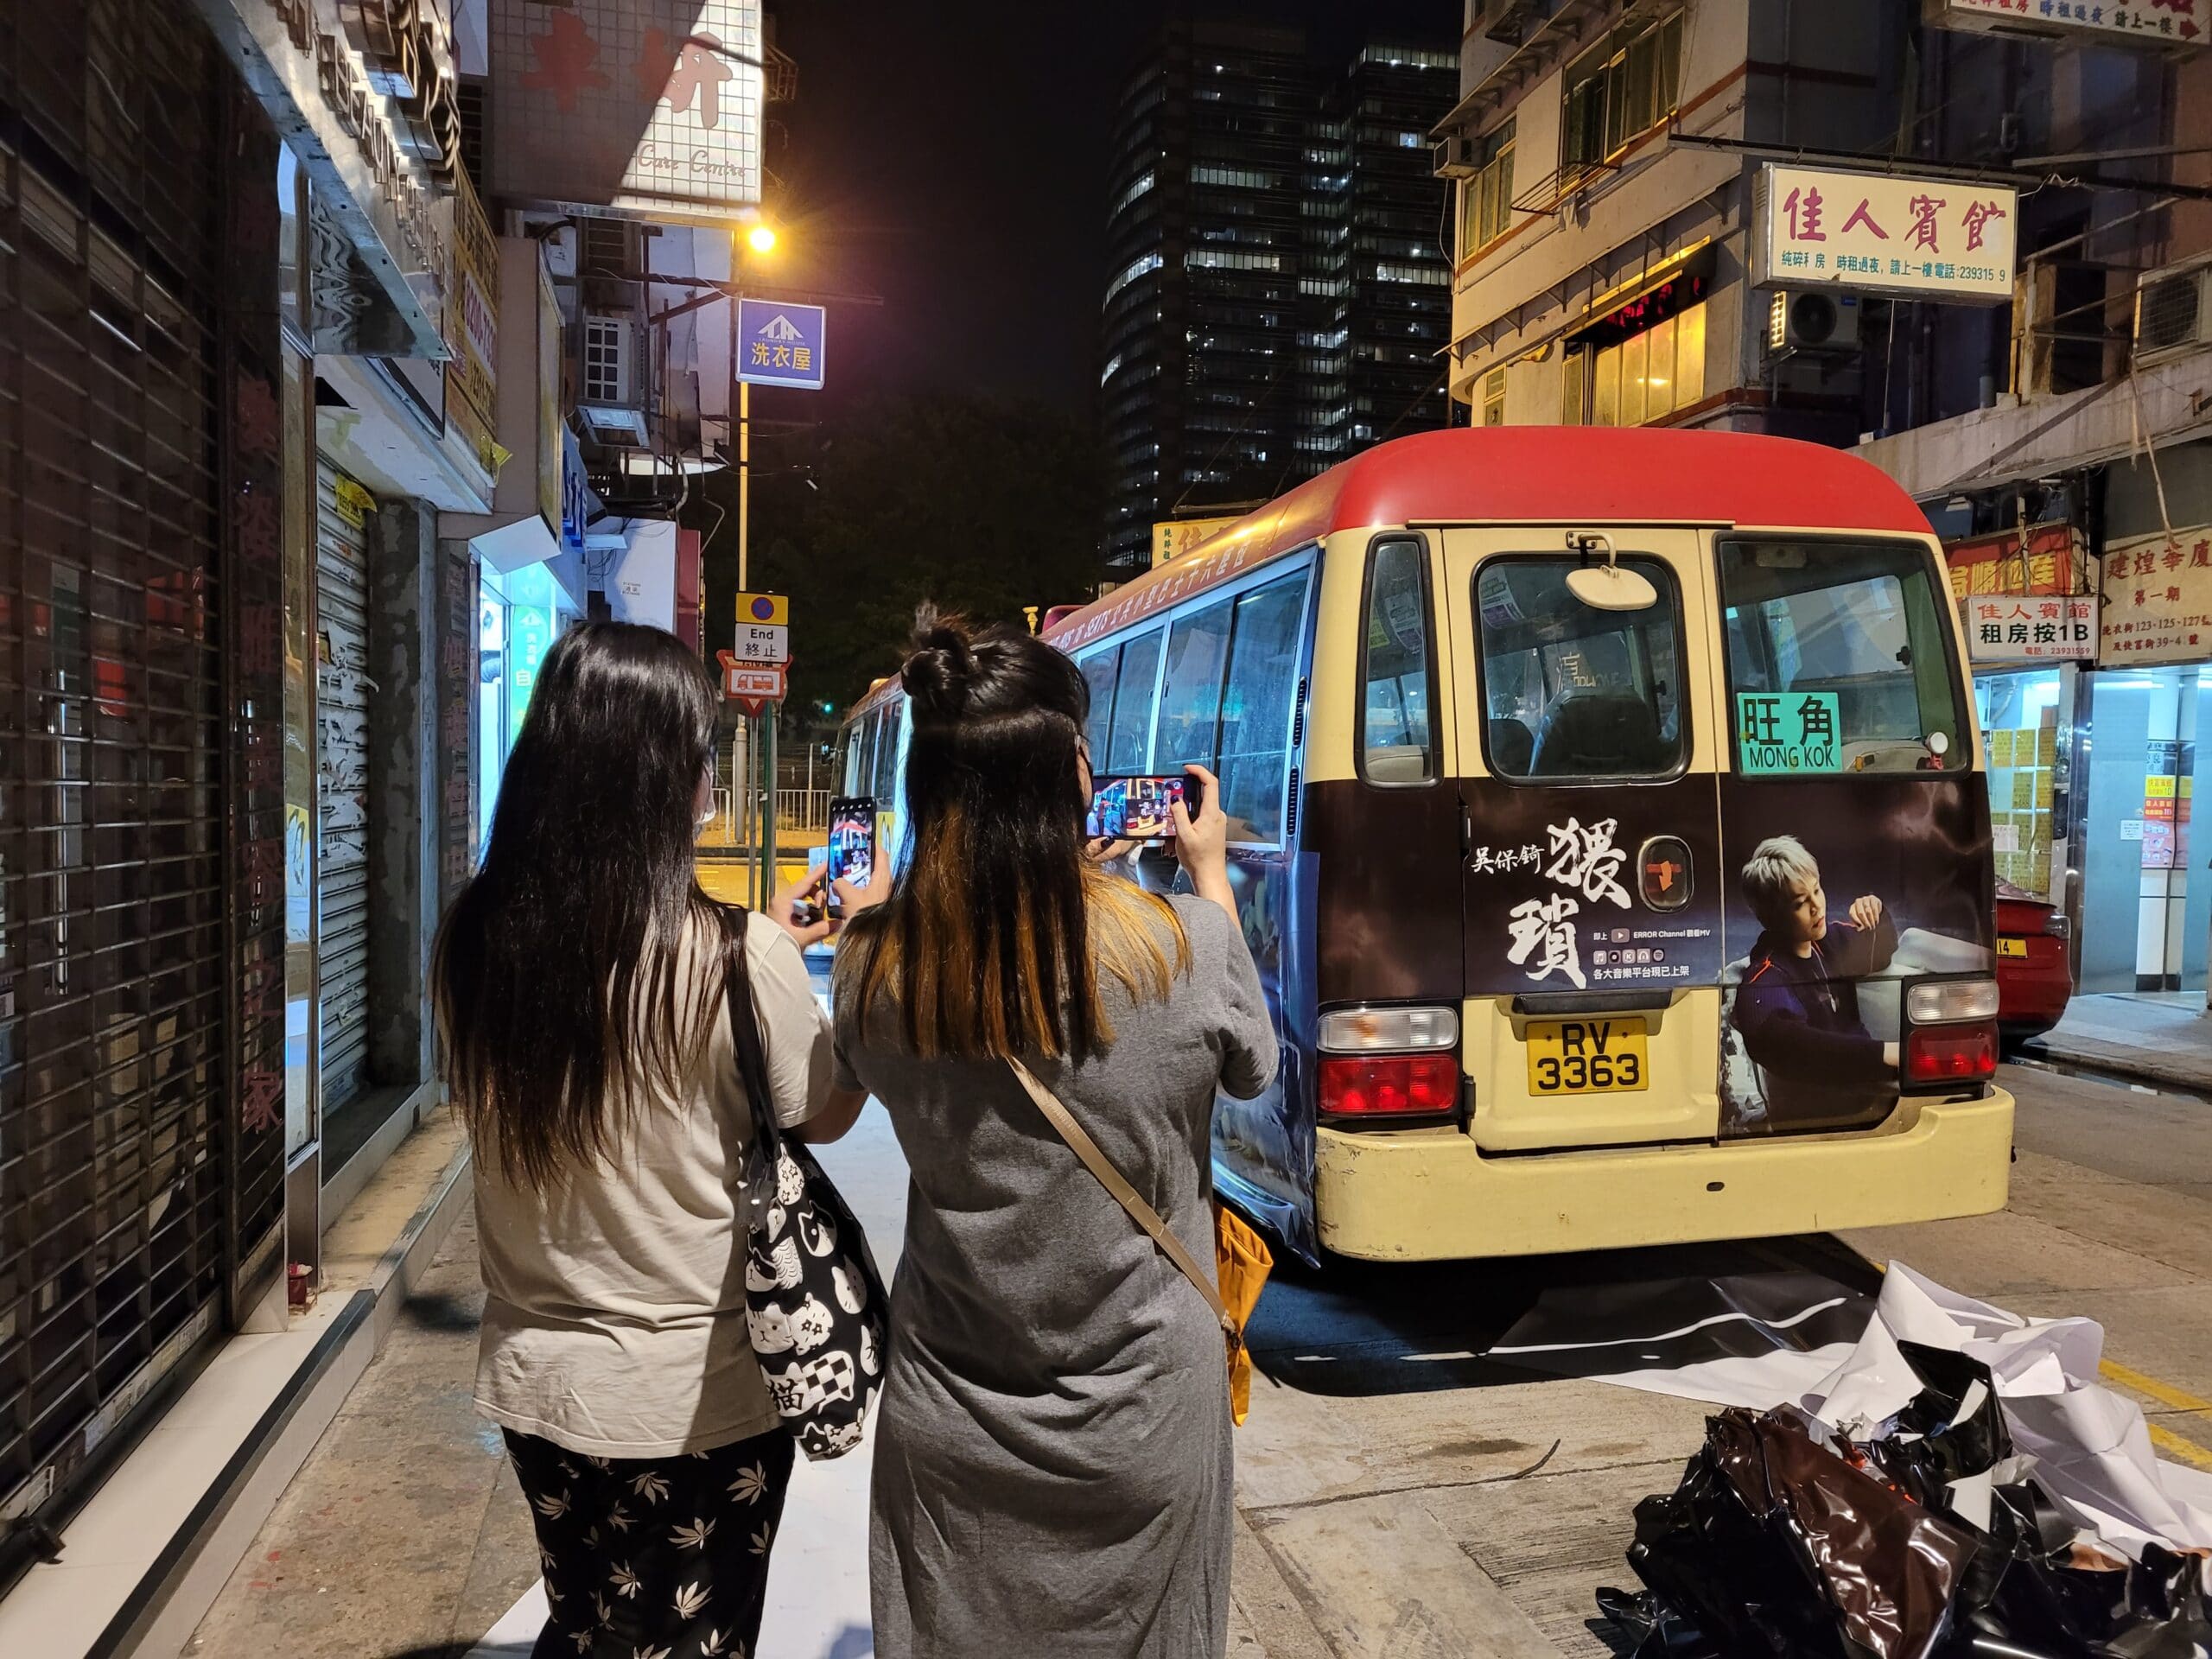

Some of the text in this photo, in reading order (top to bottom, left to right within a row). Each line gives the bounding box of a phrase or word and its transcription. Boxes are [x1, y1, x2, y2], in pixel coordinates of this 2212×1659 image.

[637, 143, 747, 178] Care Centre
[751, 341, 811, 372] 洗衣屋
[2134, 586, 2181, 607] 第一期
[1977, 602, 2092, 620] 佳人賓館
[750, 628, 774, 640] End
[1980, 623, 2089, 645] 租房按1B
[745, 642, 778, 658] 終止
[1743, 695, 1834, 747] 旺角
[1749, 746, 1835, 768] MONG KOK
[1633, 931, 1657, 939] ERROR
[1658, 929, 1686, 938] Channel
[1592, 965, 1690, 980] 各大音樂平台現已上架
[1561, 1021, 1611, 1057] RV
[1537, 1053, 1640, 1090] 3363
